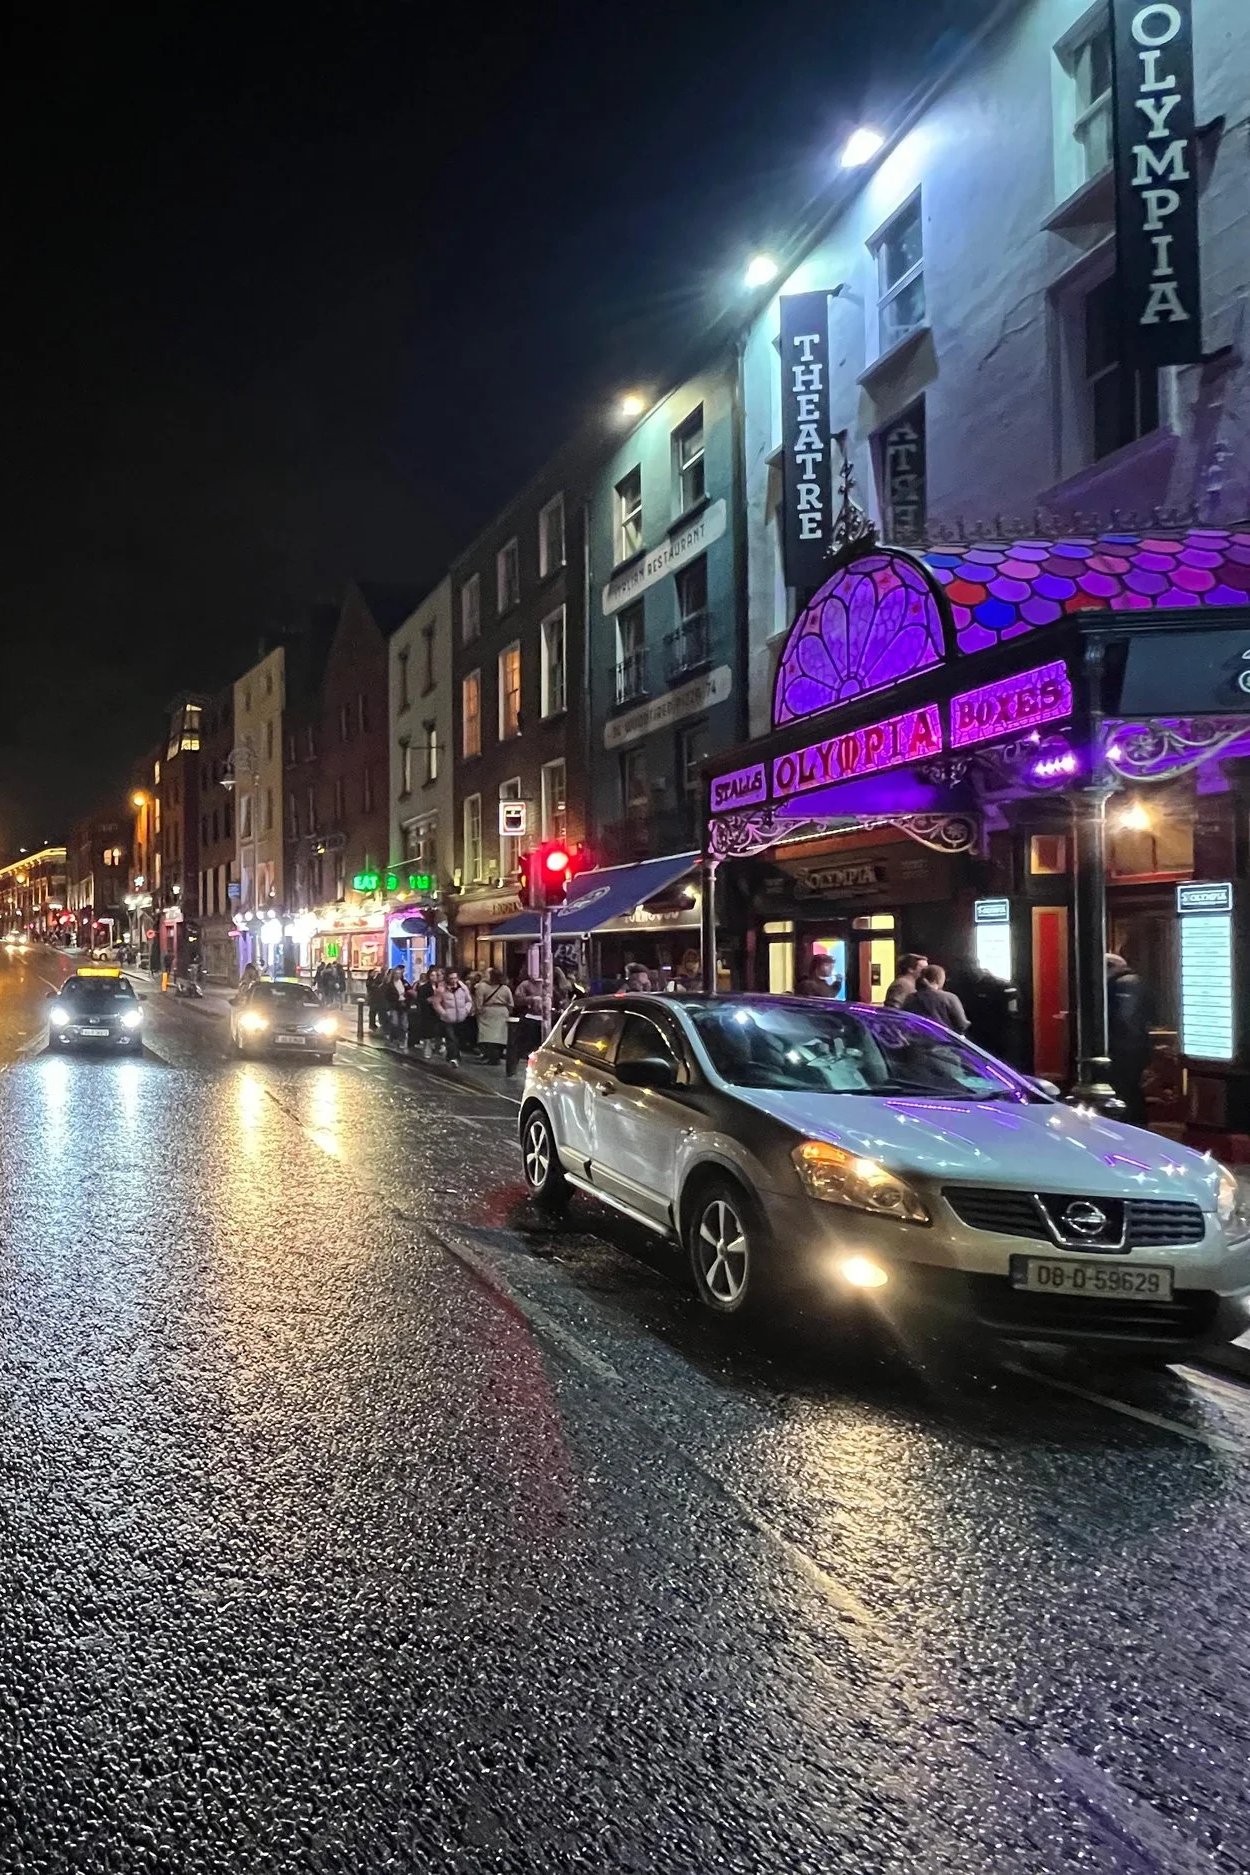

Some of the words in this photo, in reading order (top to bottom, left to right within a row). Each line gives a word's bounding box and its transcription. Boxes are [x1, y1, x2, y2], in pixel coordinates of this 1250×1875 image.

[1131, 3, 1190, 325] OLYMPIA
[792, 334, 824, 540] THEATRE
[647, 524, 705, 577] RESTAURANT
[957, 679, 1064, 731] BOXES
[775, 711, 939, 790] OLYMPIA
[715, 771, 763, 806] STALLS
[1037, 1264, 1160, 1293] 08-D-59629
